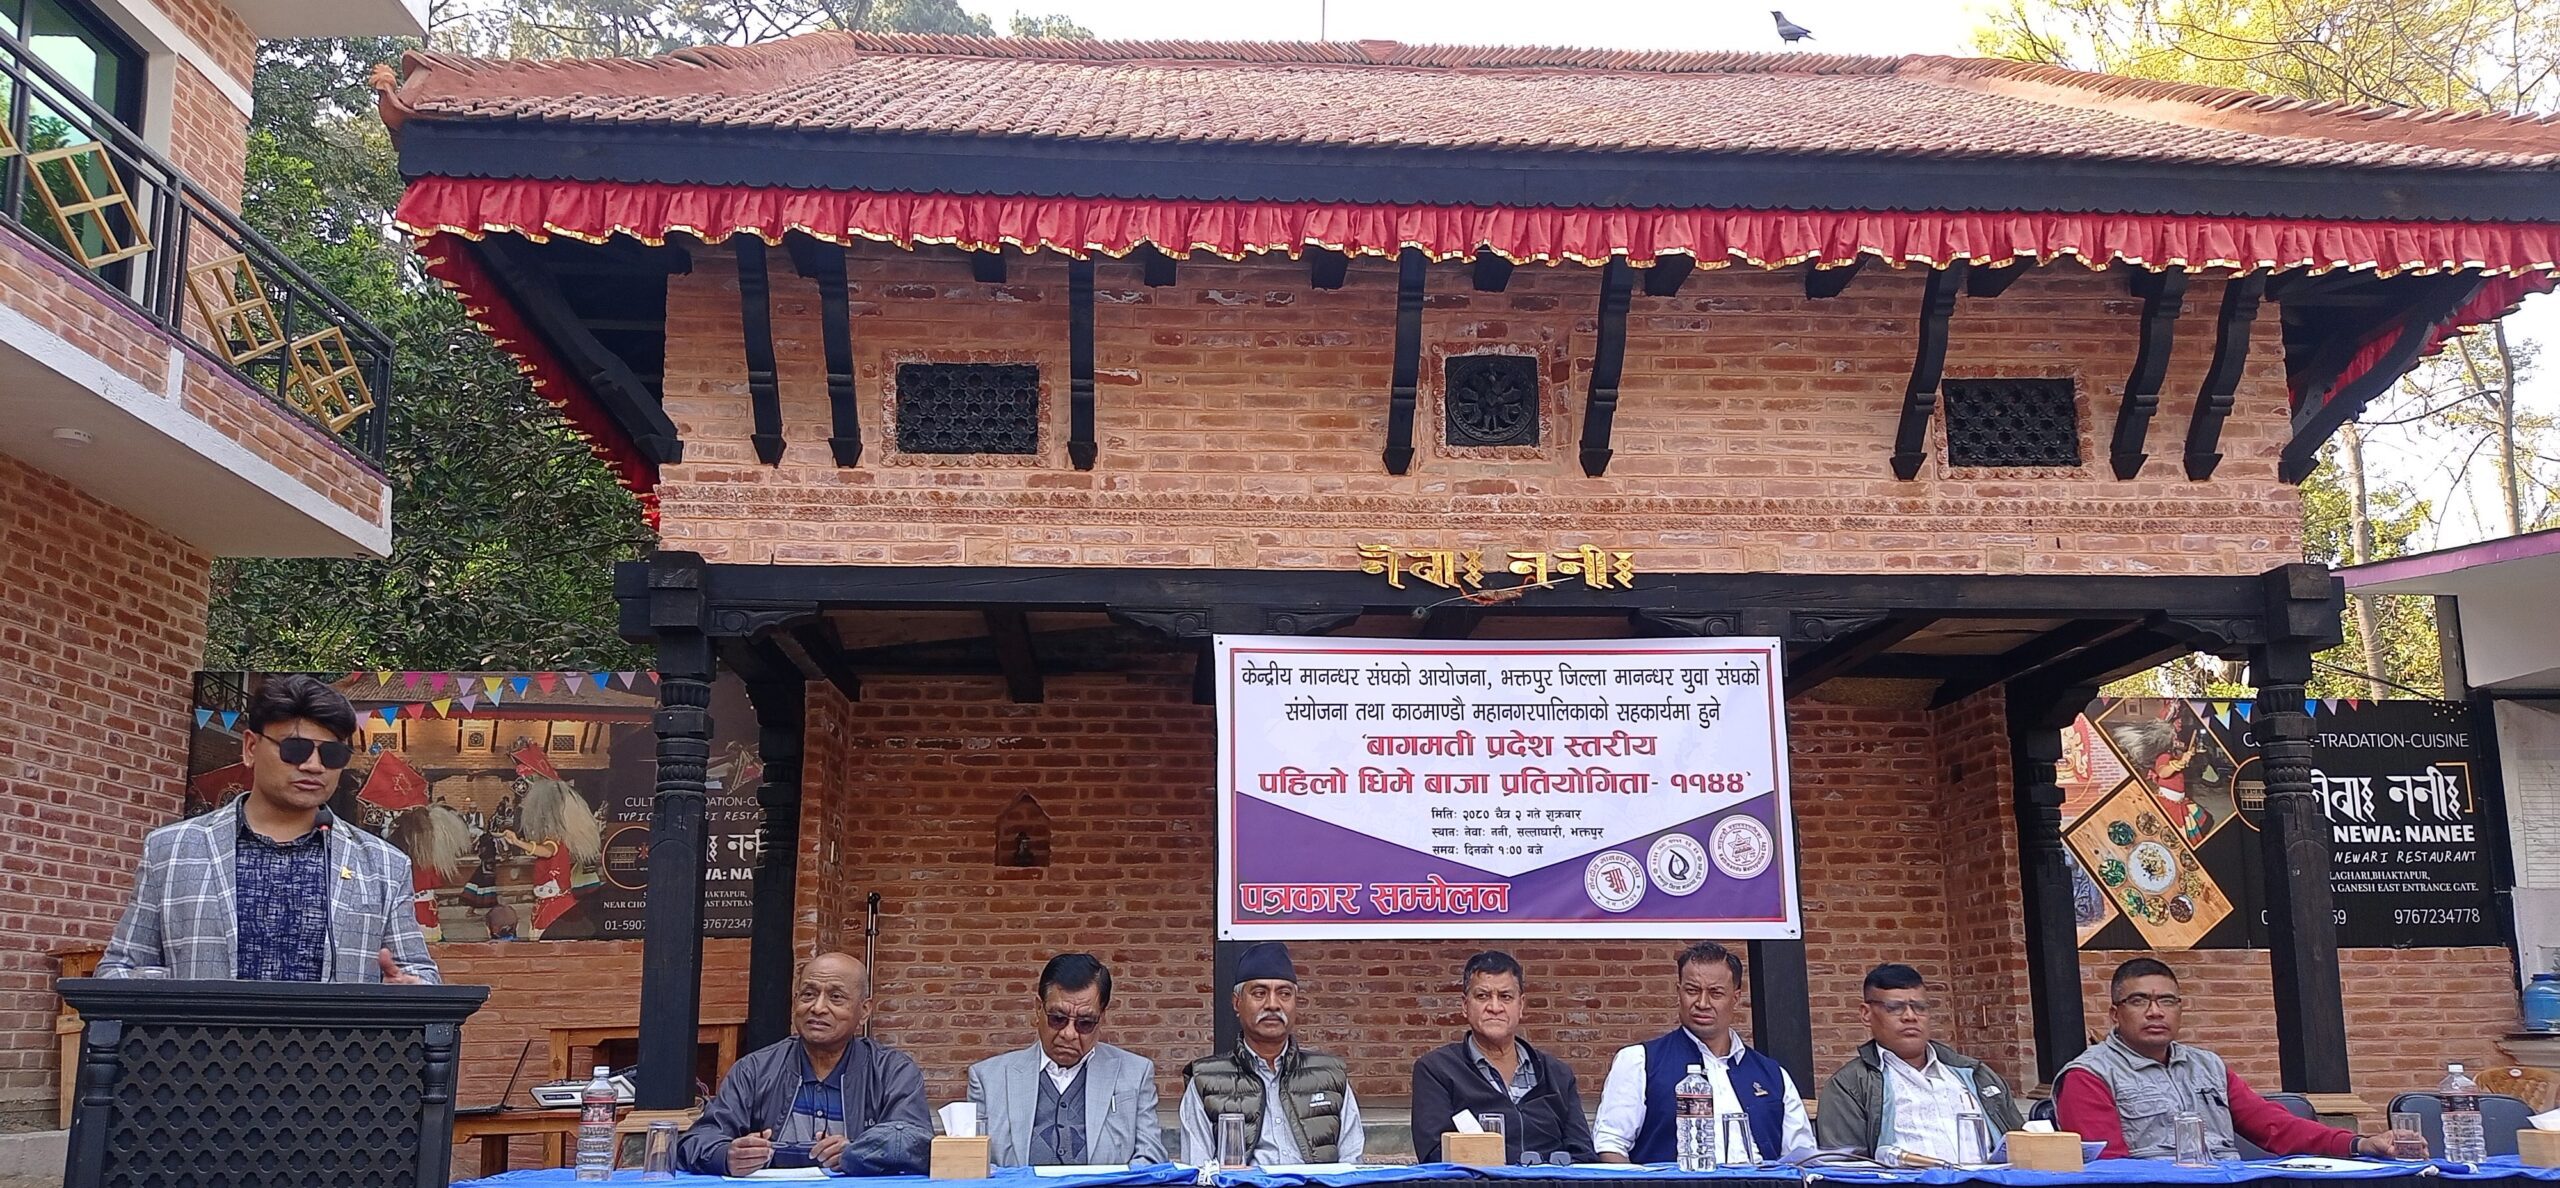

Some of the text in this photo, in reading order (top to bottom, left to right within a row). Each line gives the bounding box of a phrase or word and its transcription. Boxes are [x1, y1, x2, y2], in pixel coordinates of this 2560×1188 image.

[1241, 660, 1760, 693] केन्द्रीय मानन्धर संघको आयोजना, भक्तपुर जिल्ला मानन्धर युवा संघको
[1285, 696, 1721, 728] संयोजना तथा काठमाण्डौ महानगरपालिकाको सहकार्यमा हुने
[1486, 730, 1554, 758] प्रदेश
[1564, 730, 1657, 758] स्तरीय
[1258, 766, 1348, 795] पहिलो
[1359, 766, 1415, 794] धिमे
[1424, 774, 1490, 794] बाजा
[1462, 809, 1490, 820] २०८०
[1495, 806, 1510, 819] चैत्र
[1515, 810, 1522, 820] २
[1527, 808, 1541, 819] गते
[1517, 825, 1565, 838] सल्लाघारी,
[1571, 828, 1604, 840] भक्तपुर
[2334, 825, 2475, 843] NEWA: NANEE
[1464, 843, 1494, 856] दिनको
[2335, 850, 2476, 863] NEWARI RESTAURANT
[1239, 874, 1510, 915] पत्रकार सम्मेलन
[2338, 884, 2375, 892] GANESH
[2378, 884, 2400, 892] EAST
[2403, 883, 2452, 892] ENTRANCE
[703, 919, 752, 929] 97672347
[2394, 908, 2480, 924] 9767234778
